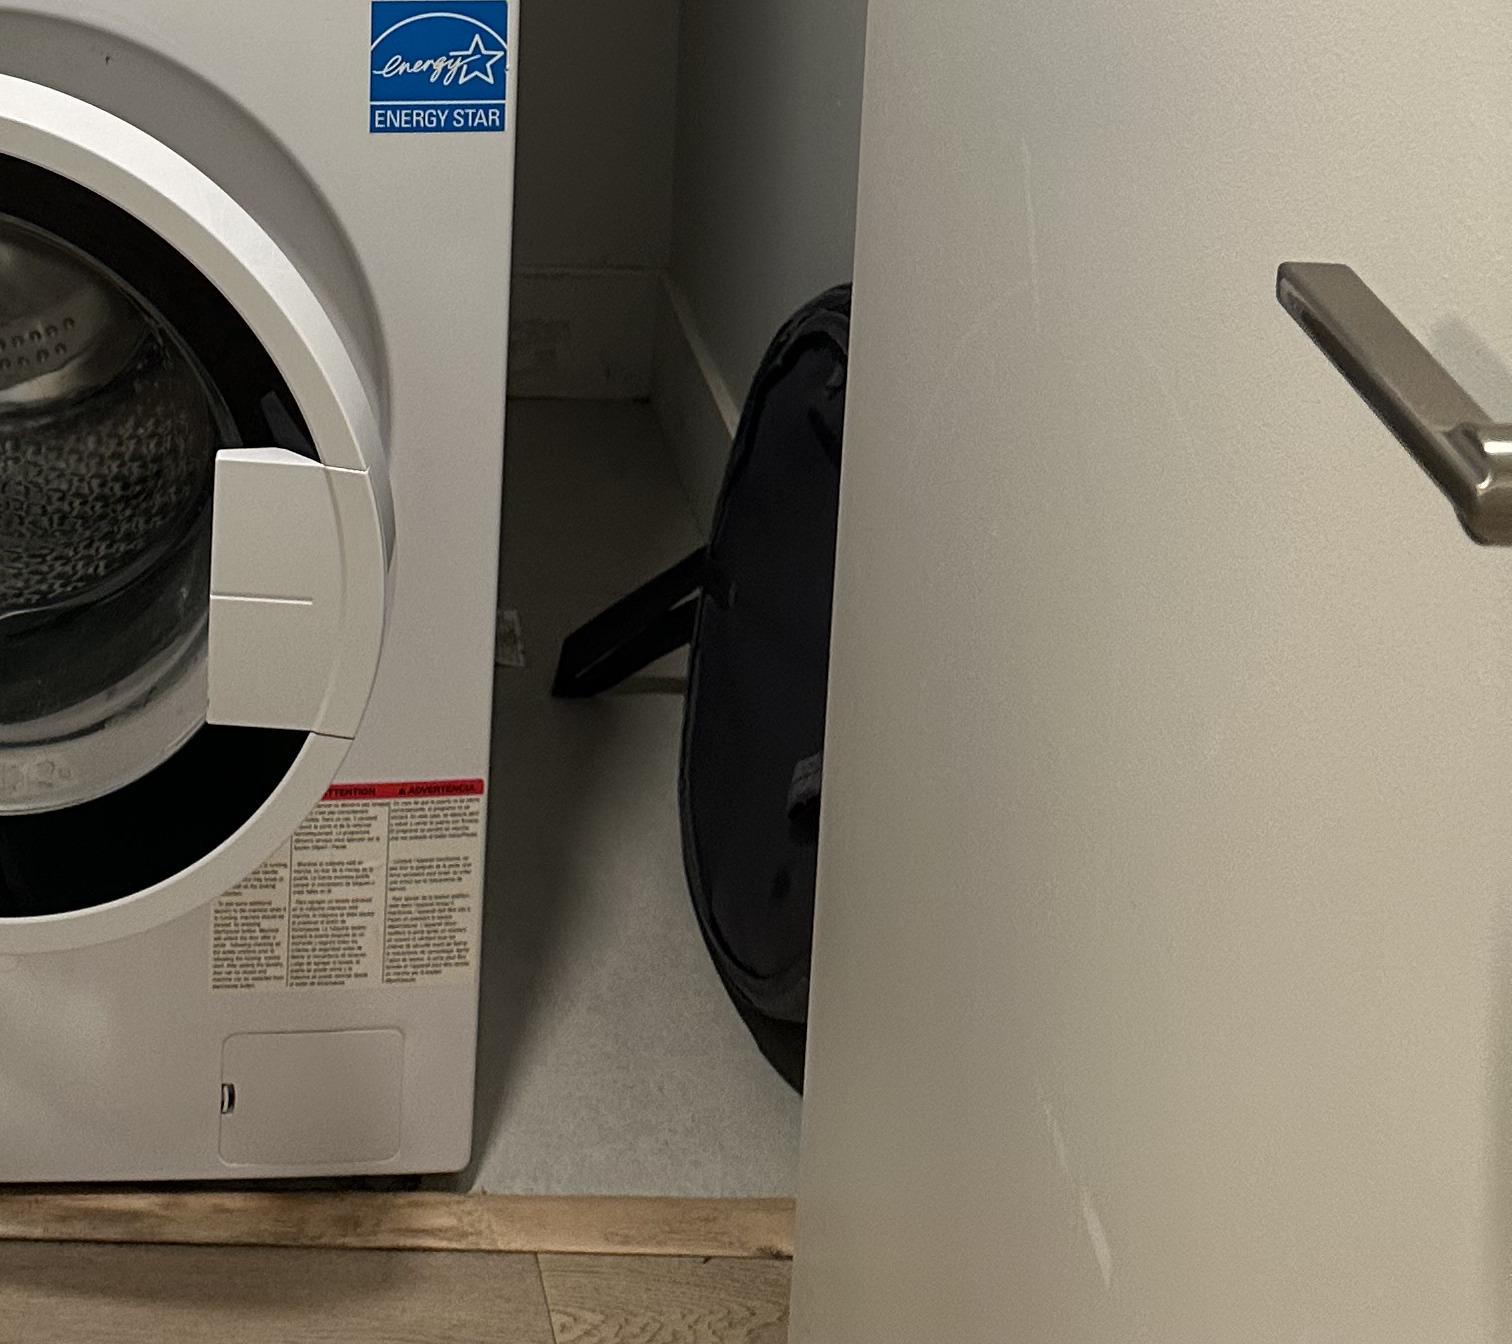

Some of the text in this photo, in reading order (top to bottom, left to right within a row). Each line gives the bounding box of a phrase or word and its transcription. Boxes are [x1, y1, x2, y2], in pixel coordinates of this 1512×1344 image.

[373, 55, 470, 86] energy
[374, 108, 500, 128] ENERGY STAR
